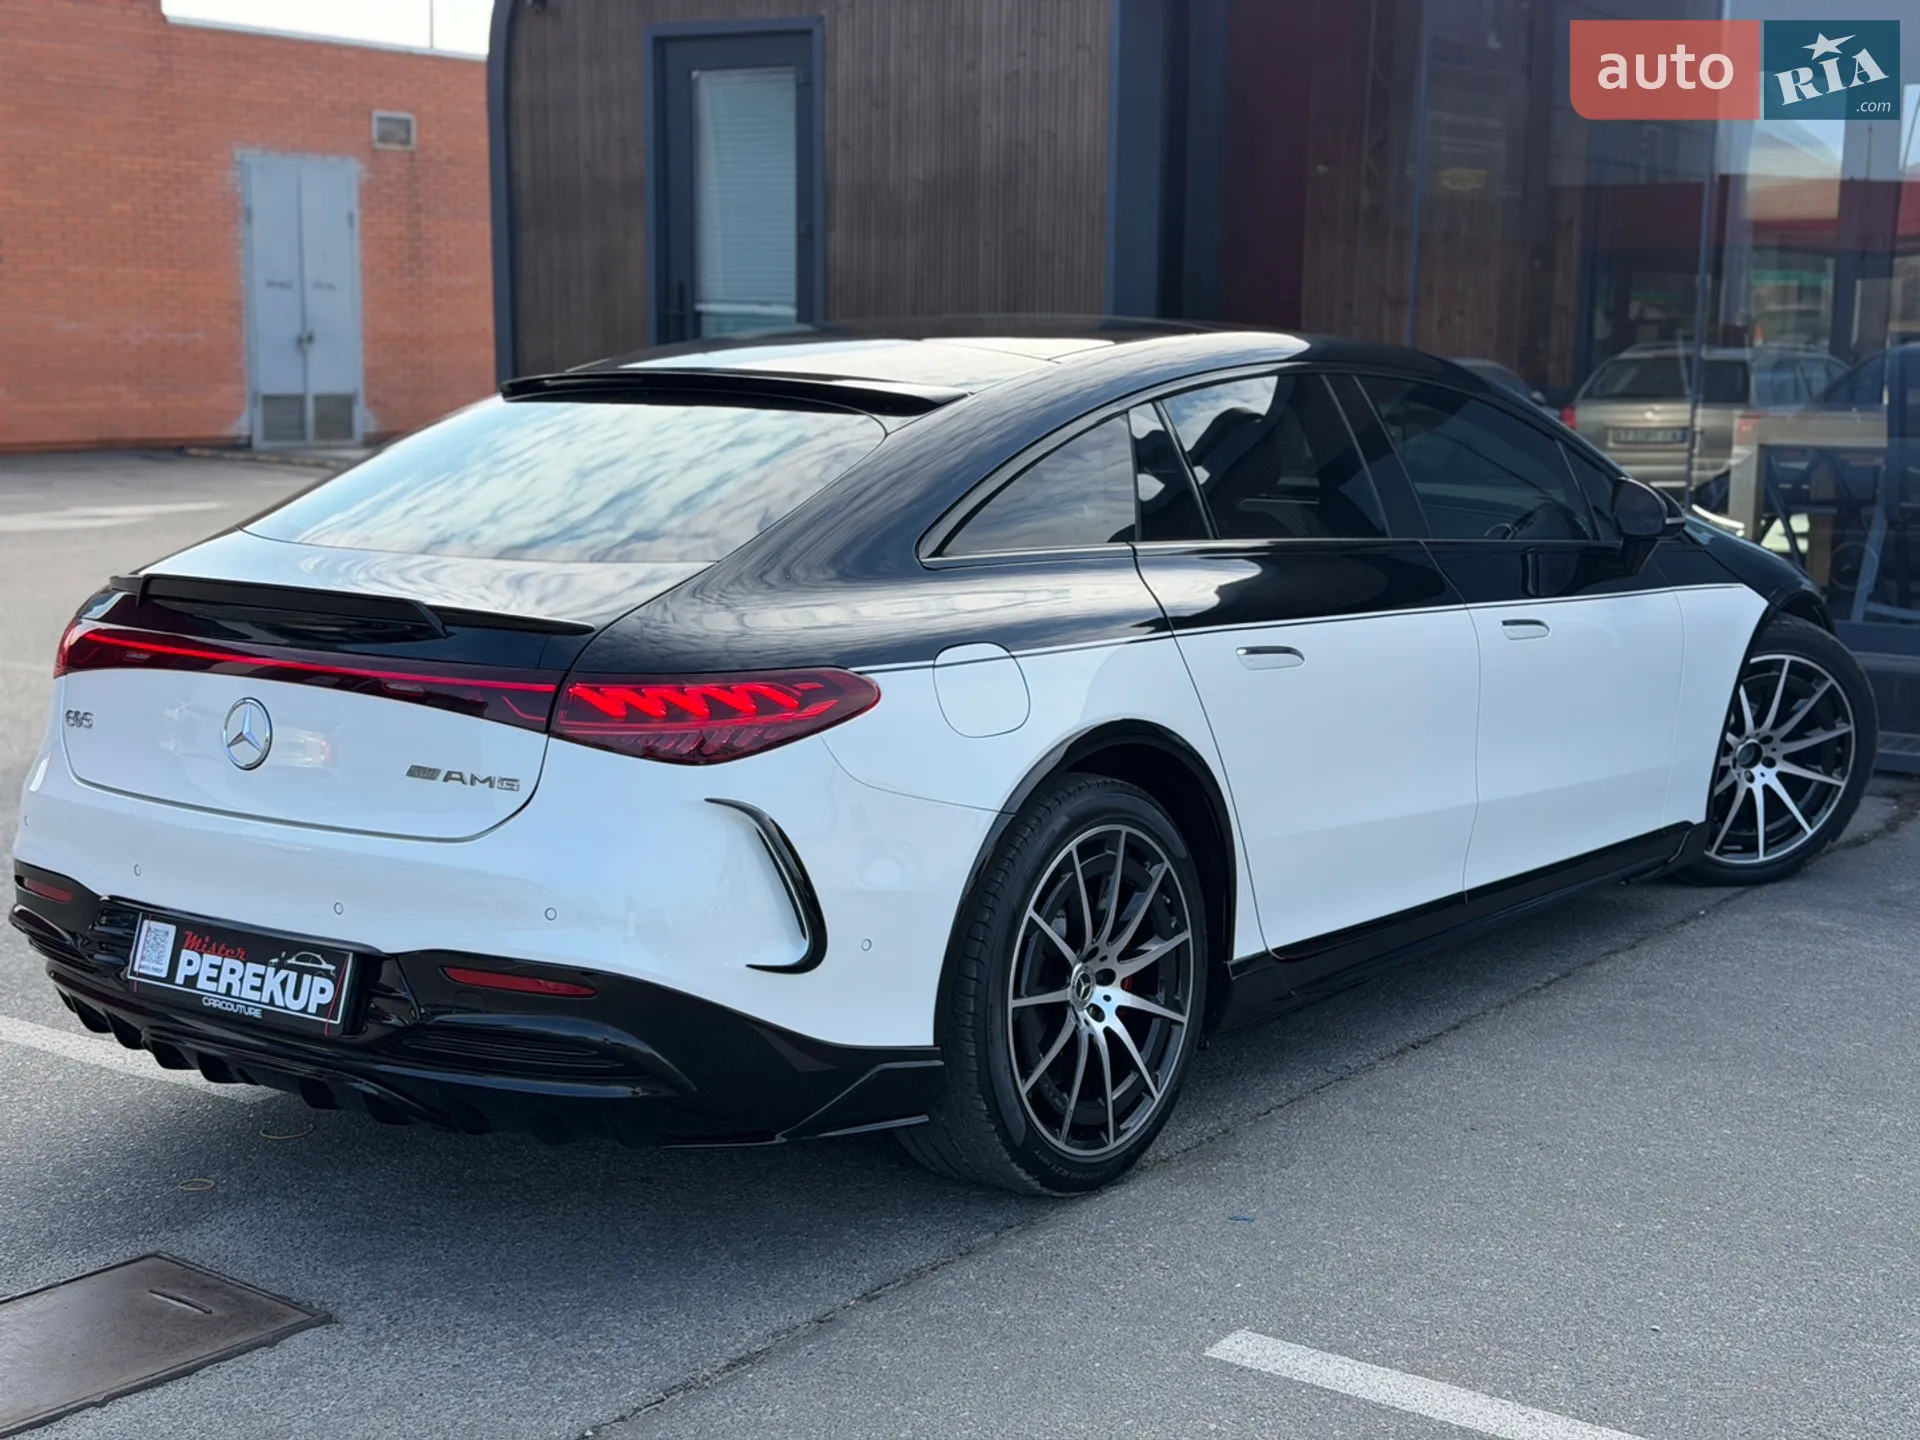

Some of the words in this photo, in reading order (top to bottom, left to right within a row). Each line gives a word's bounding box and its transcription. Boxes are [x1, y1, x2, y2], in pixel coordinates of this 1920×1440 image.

[442, 770, 520, 792] AMG
[183, 930, 247, 962] Mister
[174, 949, 335, 1014] PEREKUP
[202, 996, 263, 1019] CARCOUTURE
